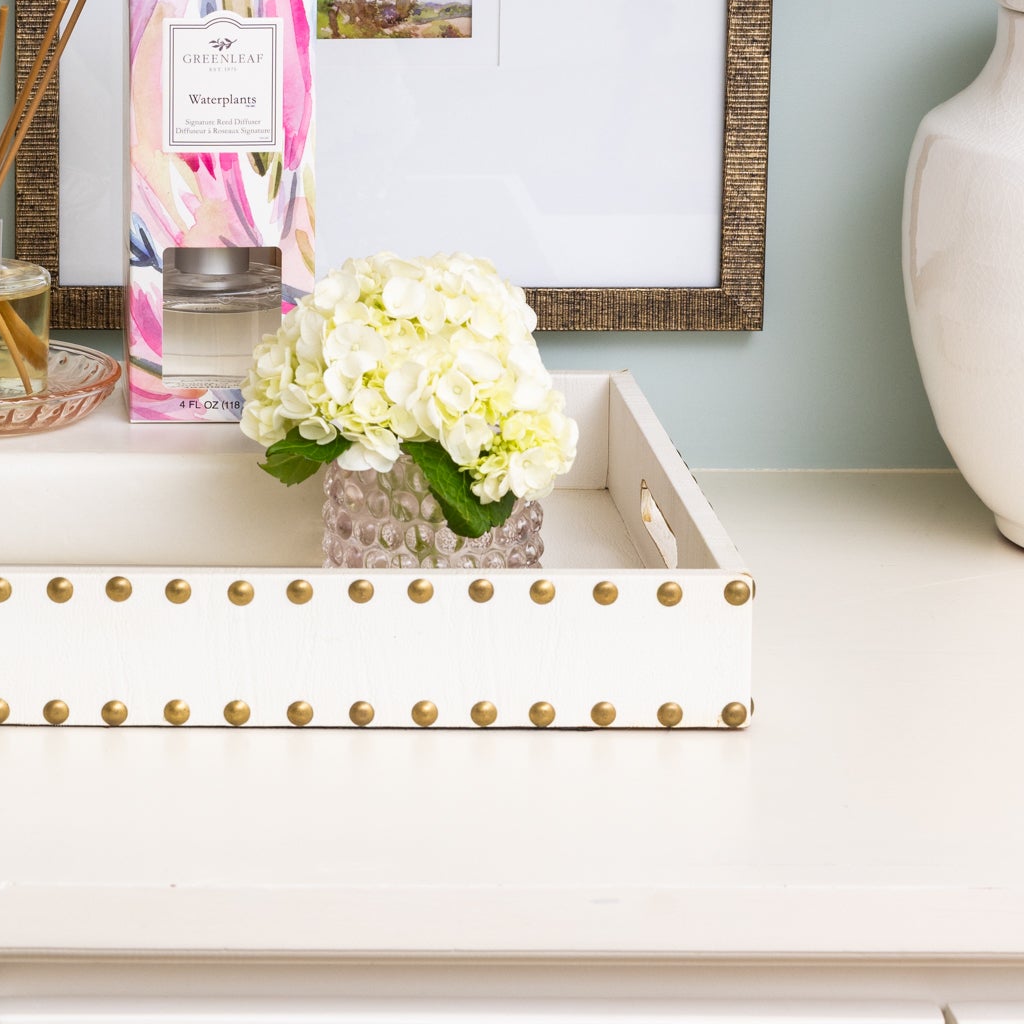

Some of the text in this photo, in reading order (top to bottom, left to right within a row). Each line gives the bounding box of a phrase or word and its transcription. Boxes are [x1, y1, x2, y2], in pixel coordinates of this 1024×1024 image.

[182, 54, 264, 64] GREENLEAF
[188, 94, 257, 108] Waterplants
[185, 118, 215, 127] Signature
[216, 118, 233, 126] Reed
[240, 127, 271, 136] Signature
[179, 400, 185, 409] 4
[189, 400, 201, 409] FL
[204, 400, 219, 409] OZ
